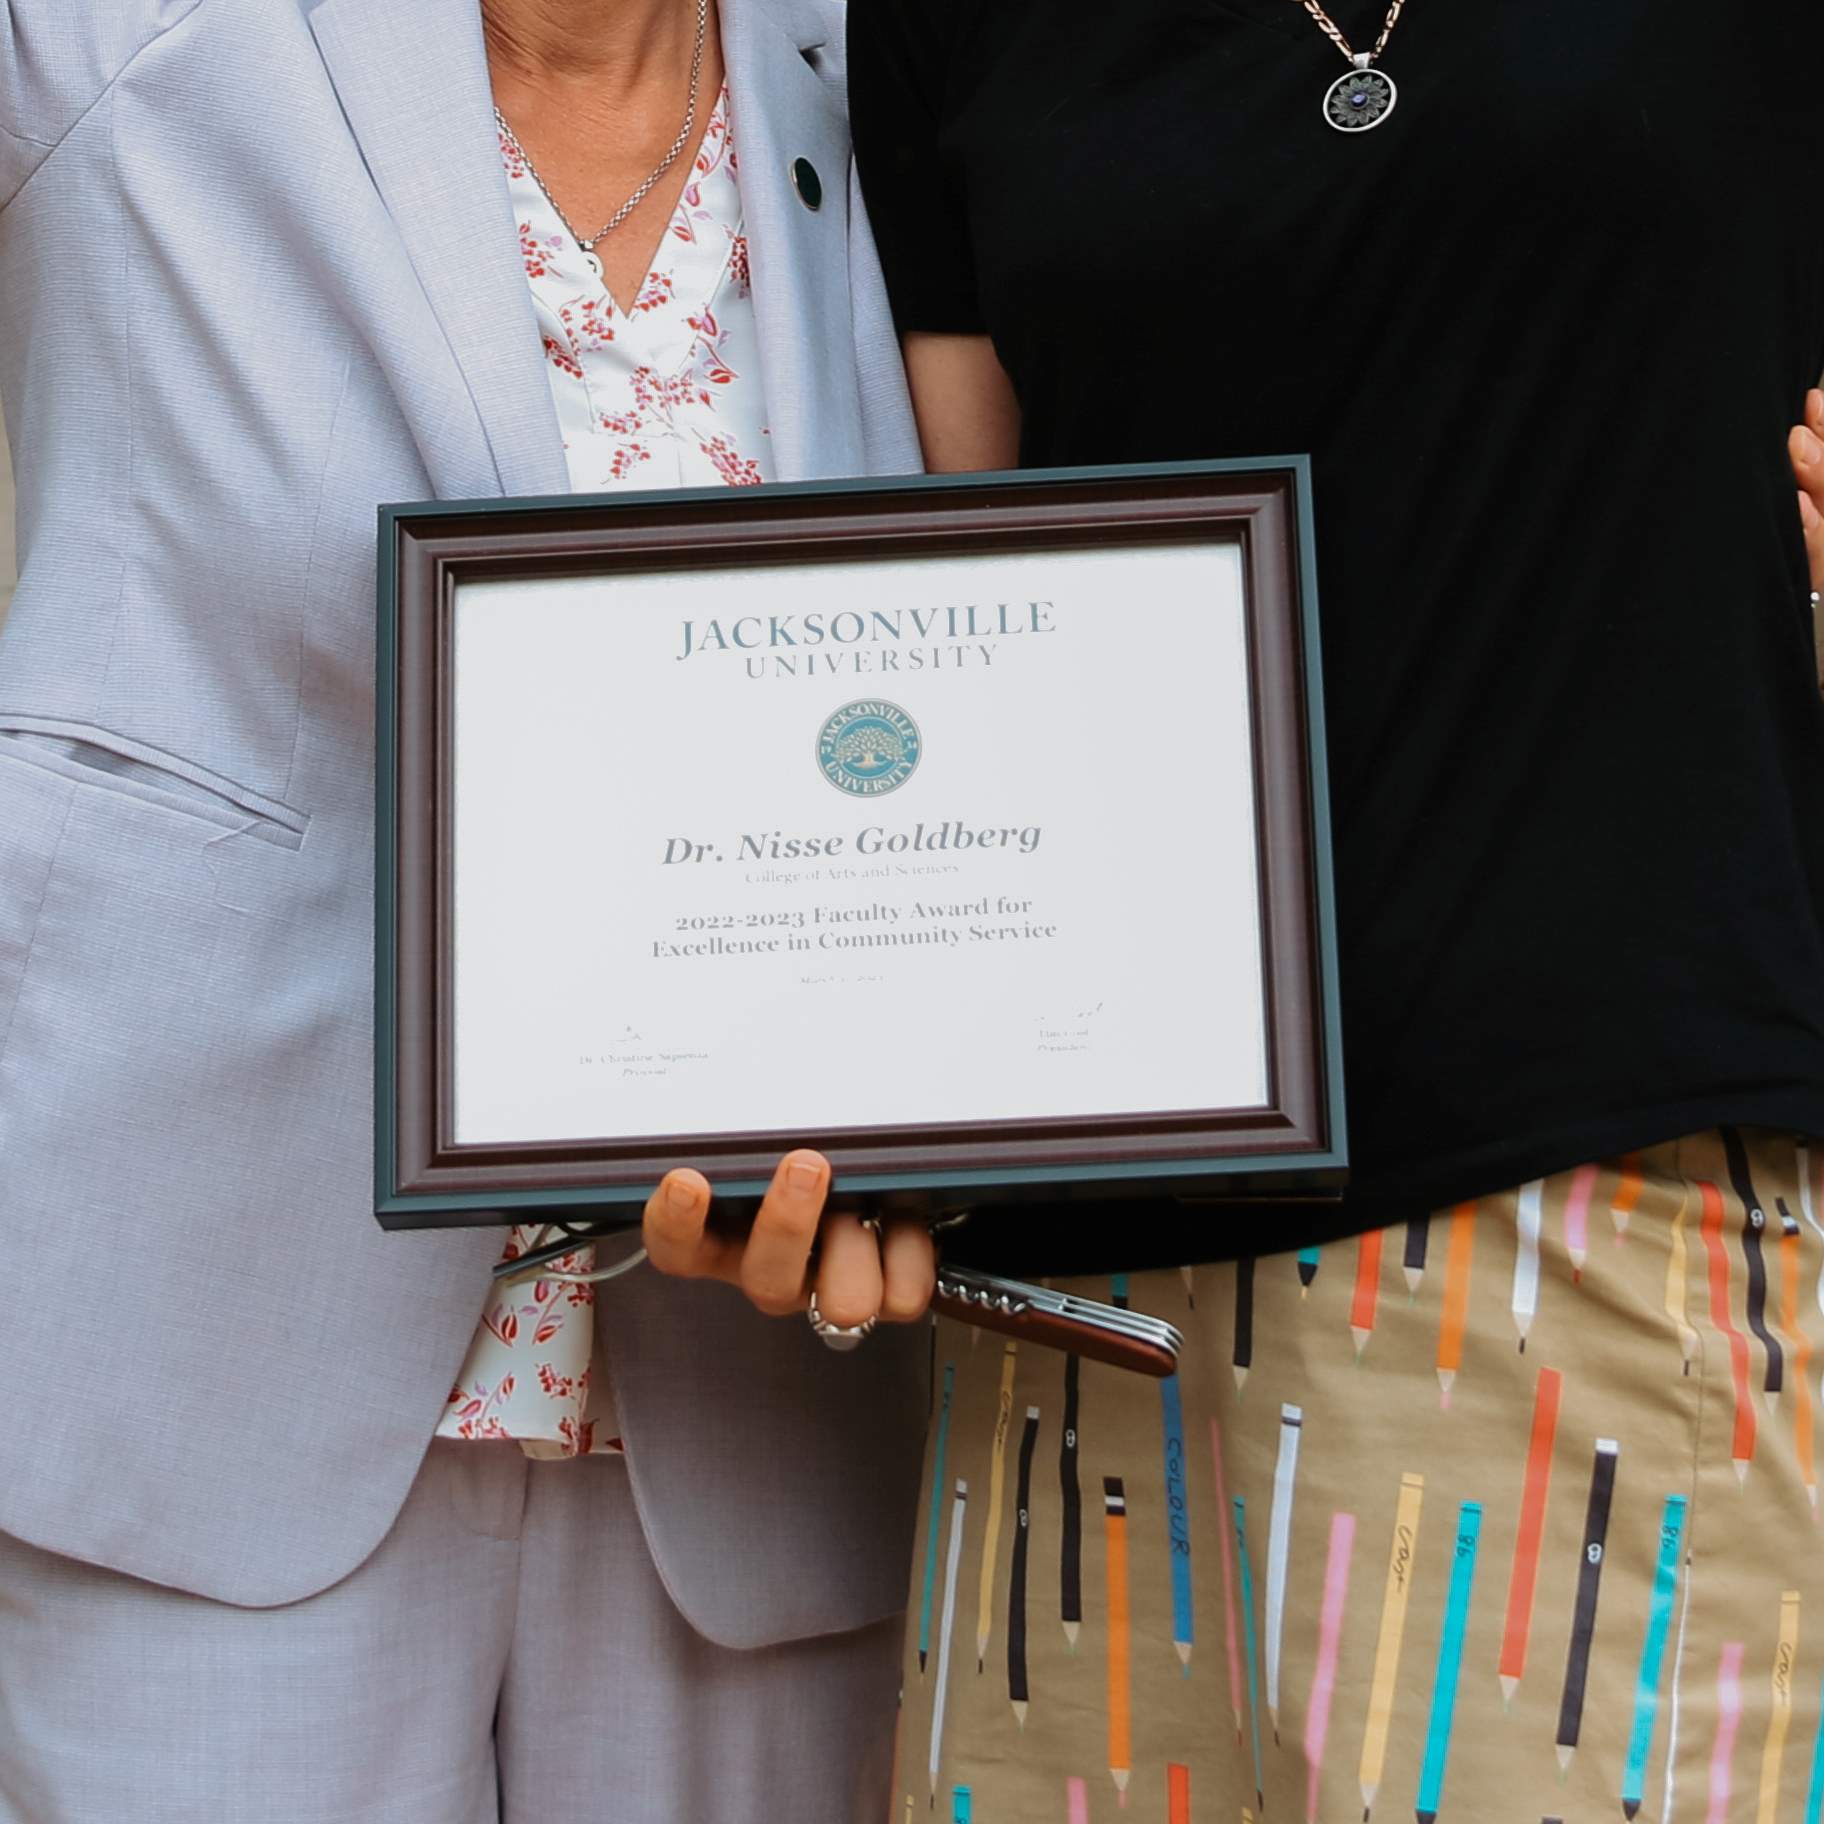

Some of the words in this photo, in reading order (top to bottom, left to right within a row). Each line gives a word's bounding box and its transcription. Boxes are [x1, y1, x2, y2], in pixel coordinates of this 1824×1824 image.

[676, 601, 1057, 661] JACKSONVILLE
[745, 644, 997, 679] UNIVERSITY
[822, 703, 916, 744] JACKSONVILLE
[824, 756, 913, 793] UNIVERSITY
[662, 838, 724, 864] Dr.
[736, 831, 844, 861] Nisse
[856, 821, 1042, 854] Goldberg
[745, 869, 801, 884] College
[828, 867, 857, 879] Arts
[675, 912, 806, 931] 2022-2023
[813, 903, 902, 924] Faculty
[910, 897, 990, 919] Award
[997, 895, 1033, 914] for
[652, 936, 780, 958] Excellence
[788, 933, 811, 951] in
[819, 925, 961, 949] Community
[969, 921, 1057, 942] Service
